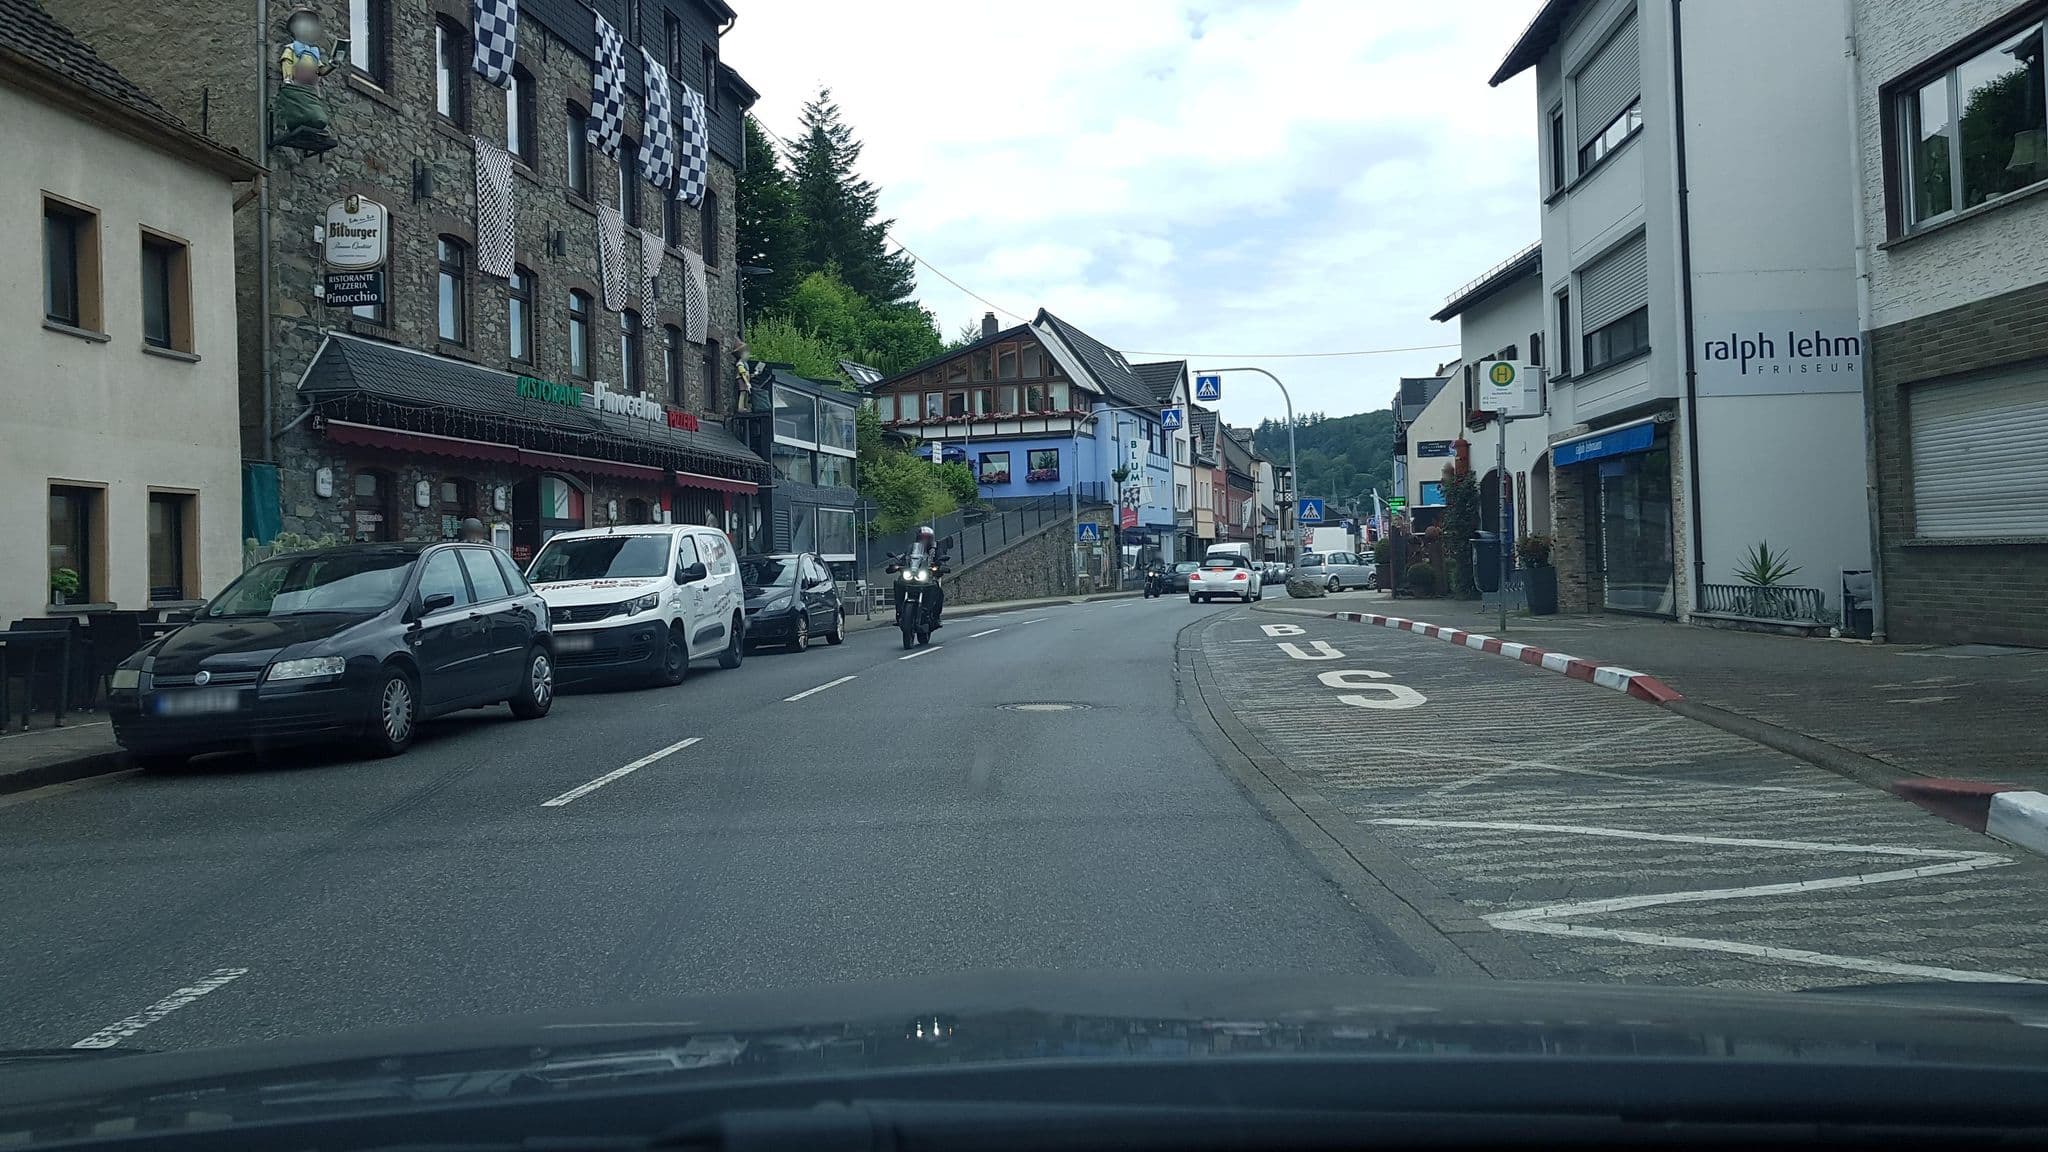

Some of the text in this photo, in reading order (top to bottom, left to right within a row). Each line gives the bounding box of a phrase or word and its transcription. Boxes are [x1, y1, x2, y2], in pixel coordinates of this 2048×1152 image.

[328, 222, 378, 240] Bitburger
[328, 273, 375, 283] RISTORANTE
[334, 281, 368, 291] PIZZERIA
[326, 290, 378, 304] Pinocchio
[1704, 331, 1775, 375] ralph
[1758, 362, 1854, 375] FRISEUR
[516, 376, 584, 408] RISTORANTE
[593, 380, 662, 422] Pinocchio
[1130, 440, 1140, 486] BLUM
